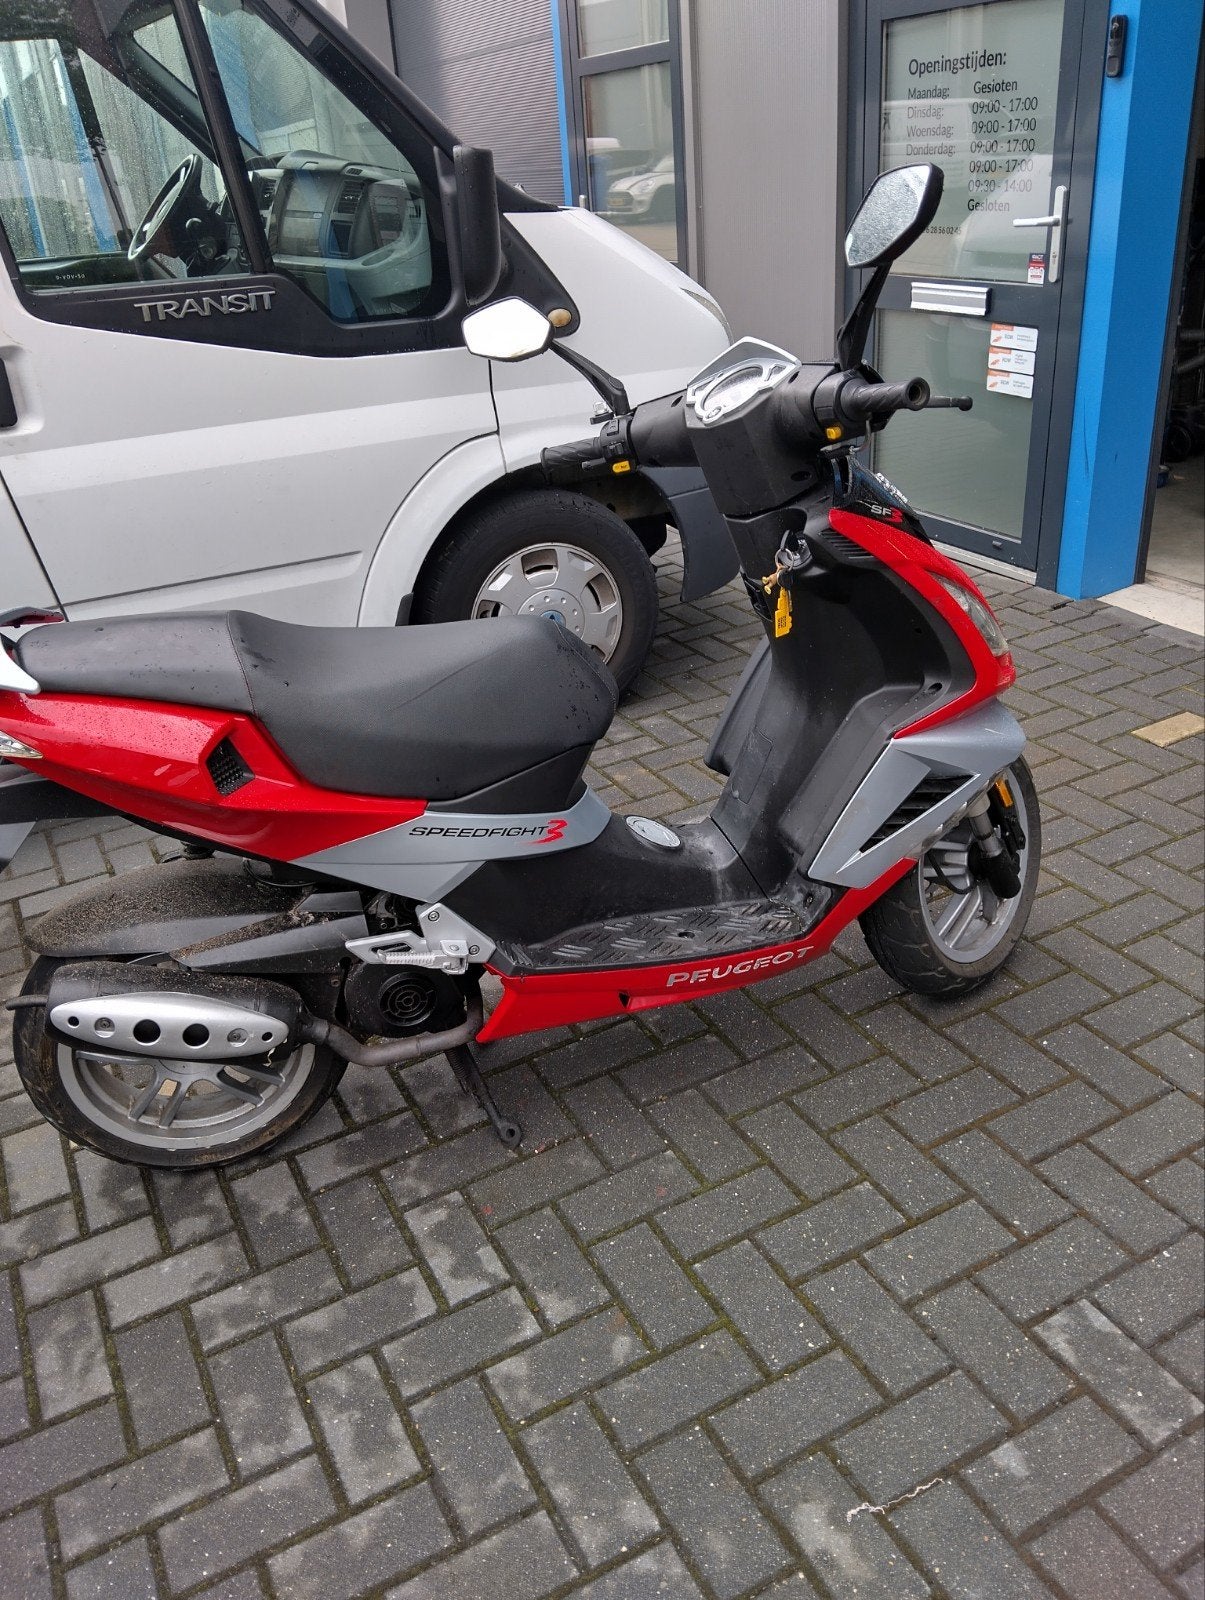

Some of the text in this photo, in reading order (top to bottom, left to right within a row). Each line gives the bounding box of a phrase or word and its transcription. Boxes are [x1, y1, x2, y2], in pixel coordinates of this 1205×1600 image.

[908, 49, 1007, 78] Openingstijden:
[908, 85, 950, 100] Maandag:
[907, 104, 944, 120] Dinsdag:
[972, 99, 1000, 114] 09:00
[1009, 96, 1038, 112] 17:00
[906, 123, 954, 138] Woensdag:
[971, 119, 999, 134] 09:00
[1008, 117, 1037, 132] 17:00
[906, 142, 956, 157] Donderdag:
[970, 140, 998, 153] 09:00
[1007, 138, 1036, 152] 17:00
[969, 159, 997, 173] 09:00
[1005, 158, 1034, 172] 17:00
[968, 179, 996, 192] 09:30
[1004, 179, 1032, 192] 14:00
[967, 198, 1010, 212] Gesloten
[134, 290, 276, 322] TRANSIT
[666, 945, 815, 987] PEUGEOT
